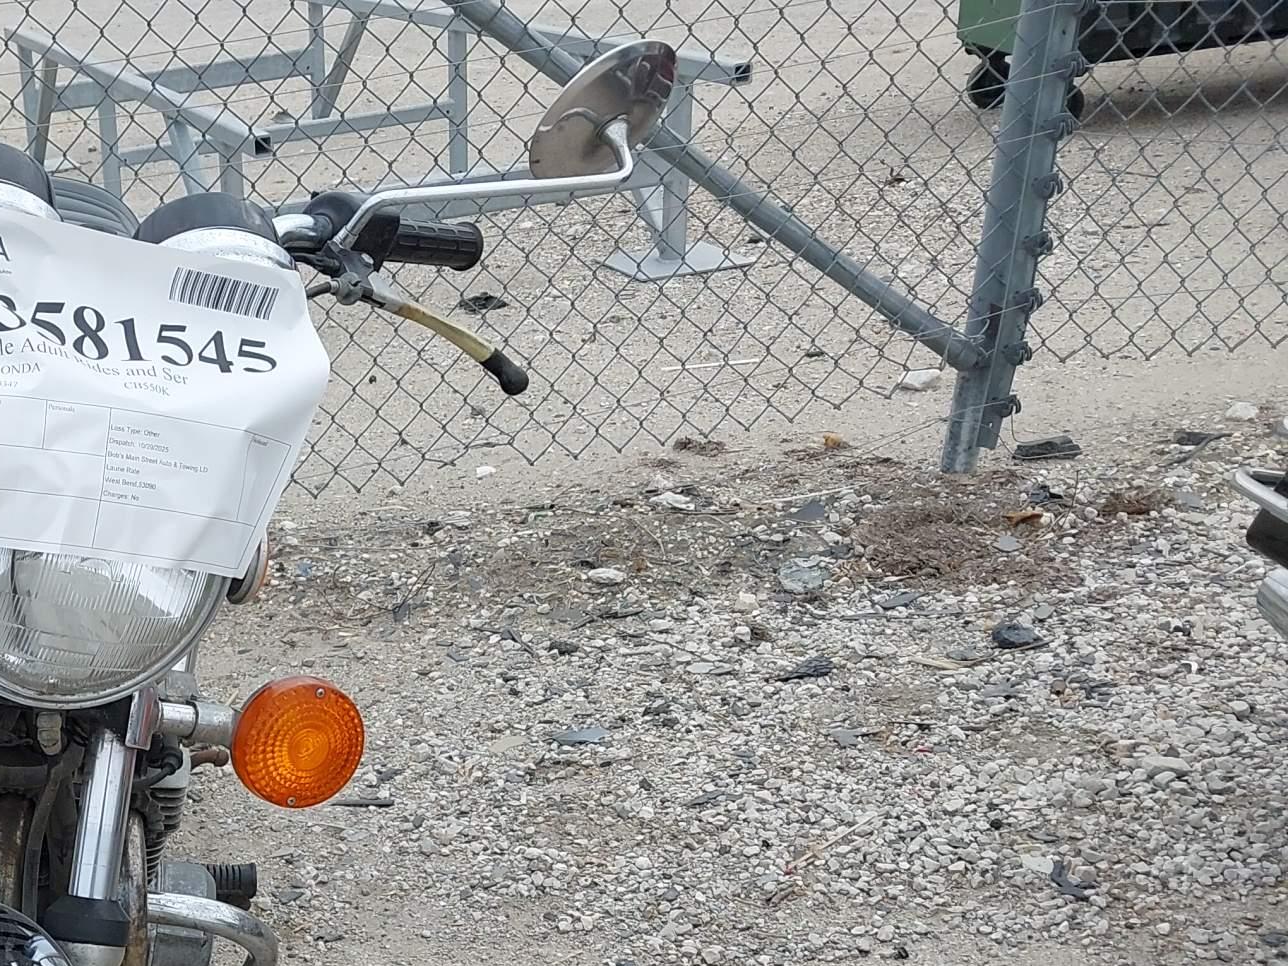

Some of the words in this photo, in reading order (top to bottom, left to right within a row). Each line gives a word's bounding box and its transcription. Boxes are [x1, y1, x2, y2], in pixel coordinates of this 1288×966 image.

[126, 365, 157, 378] and
[162, 367, 189, 385] Ser
[110, 424, 126, 433] Loss
[144, 429, 160, 438] Other
[125, 453, 140, 463] Main
[140, 456, 158, 465] Street
[104, 476, 121, 486] West
